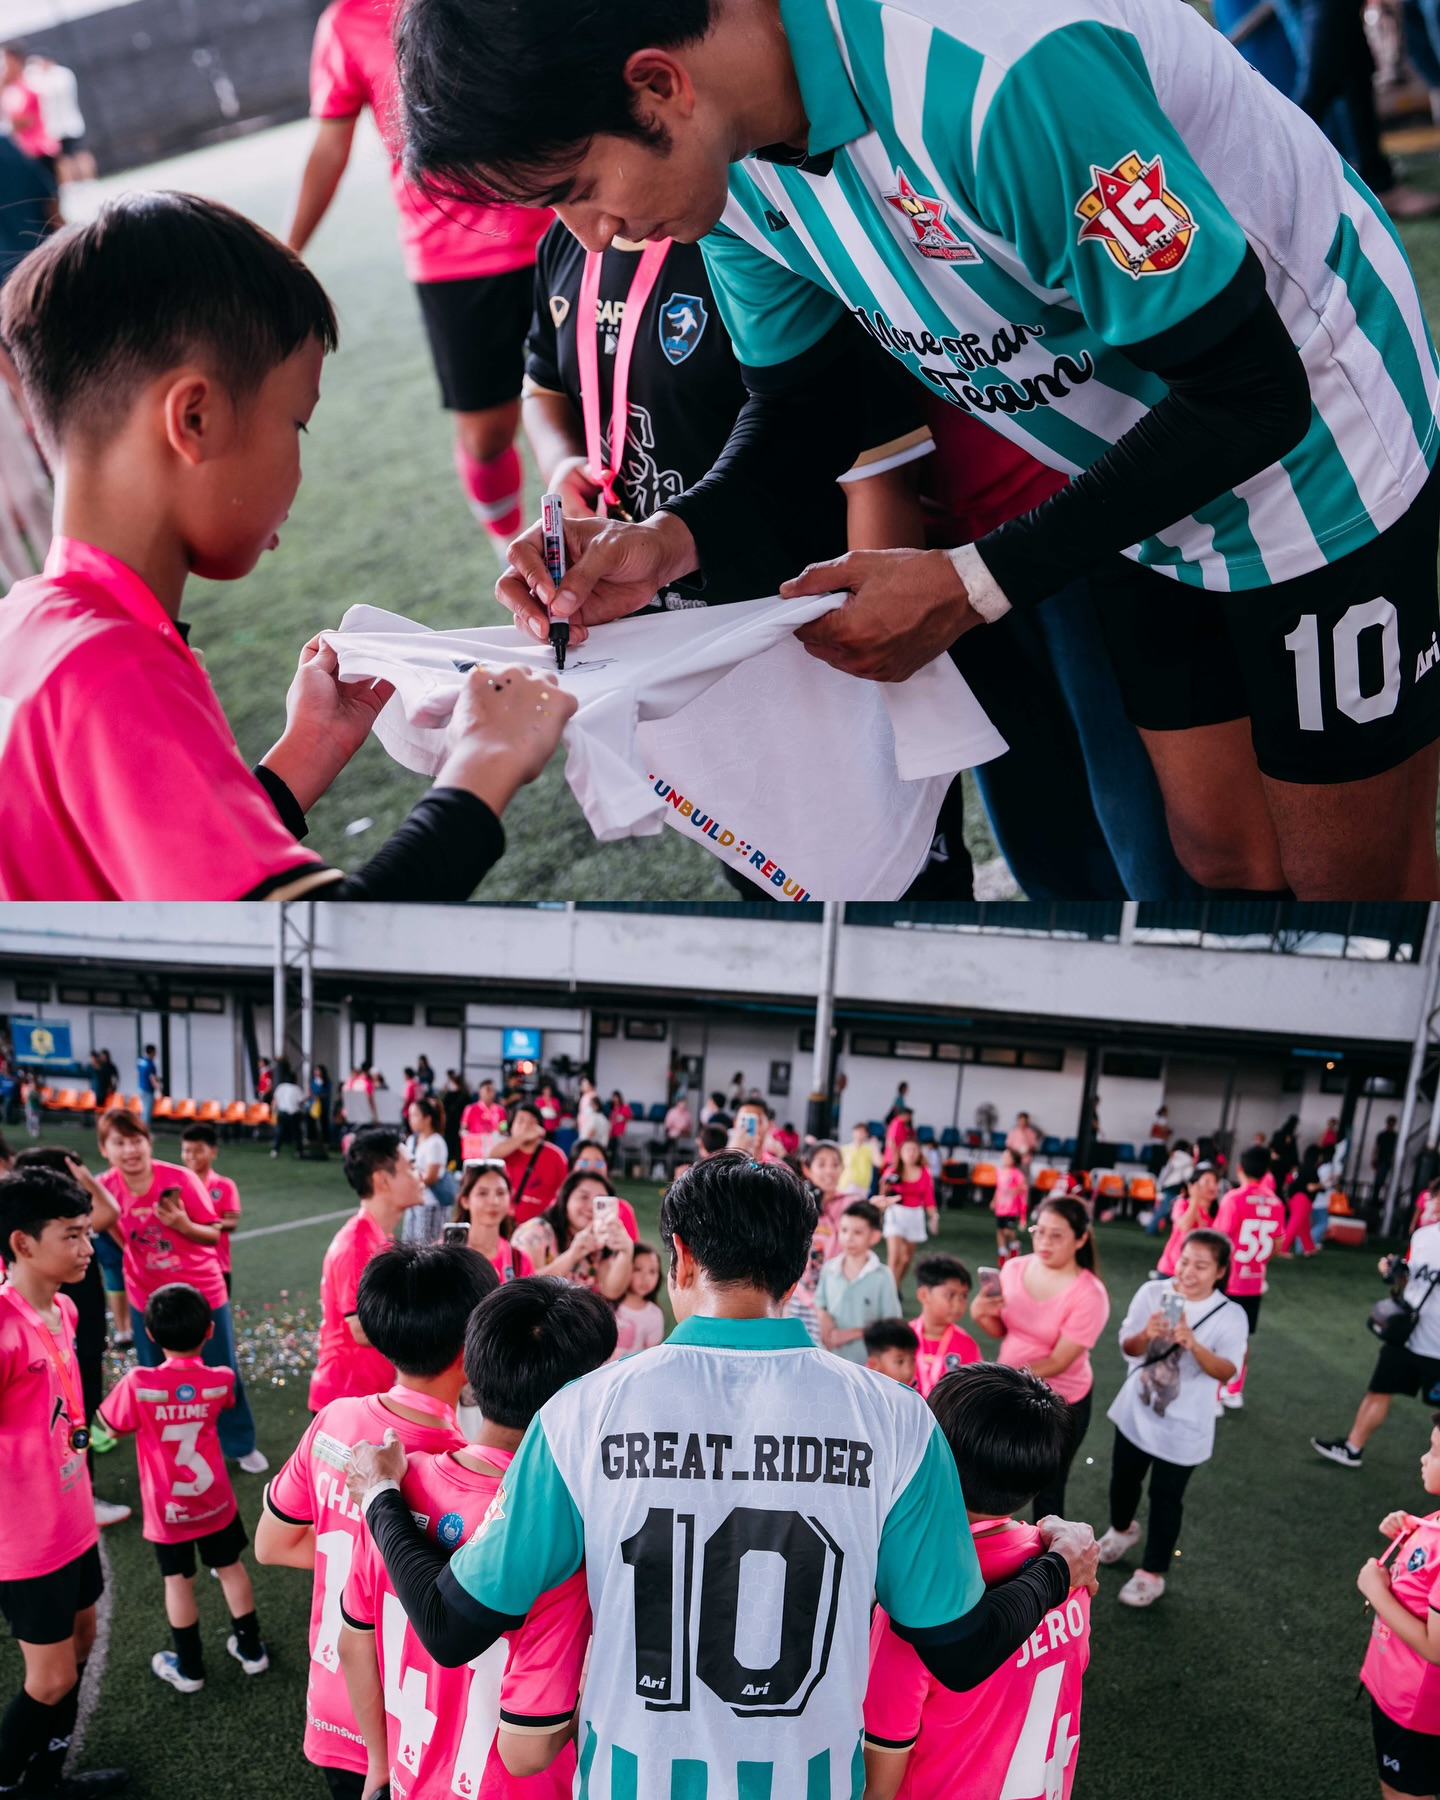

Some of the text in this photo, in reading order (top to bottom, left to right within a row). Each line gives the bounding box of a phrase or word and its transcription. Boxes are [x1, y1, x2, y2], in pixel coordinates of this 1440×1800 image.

[1097, 178, 1178, 262] 15
[851, 307, 1045, 371] More Than
[919, 350, 1094, 414] Team
[1284, 596, 1401, 731] 10
[653, 779, 735, 847] UNBUILD
[1234, 1218, 1279, 1263] 55
[155, 1404, 210, 1421] ATIME
[161, 1421, 215, 1496] 3
[621, 1507, 844, 1717] 10
[383, 1591, 510, 1800] 41
[638, 1674, 667, 1690] Ari
[740, 1681, 771, 1696] Ari
